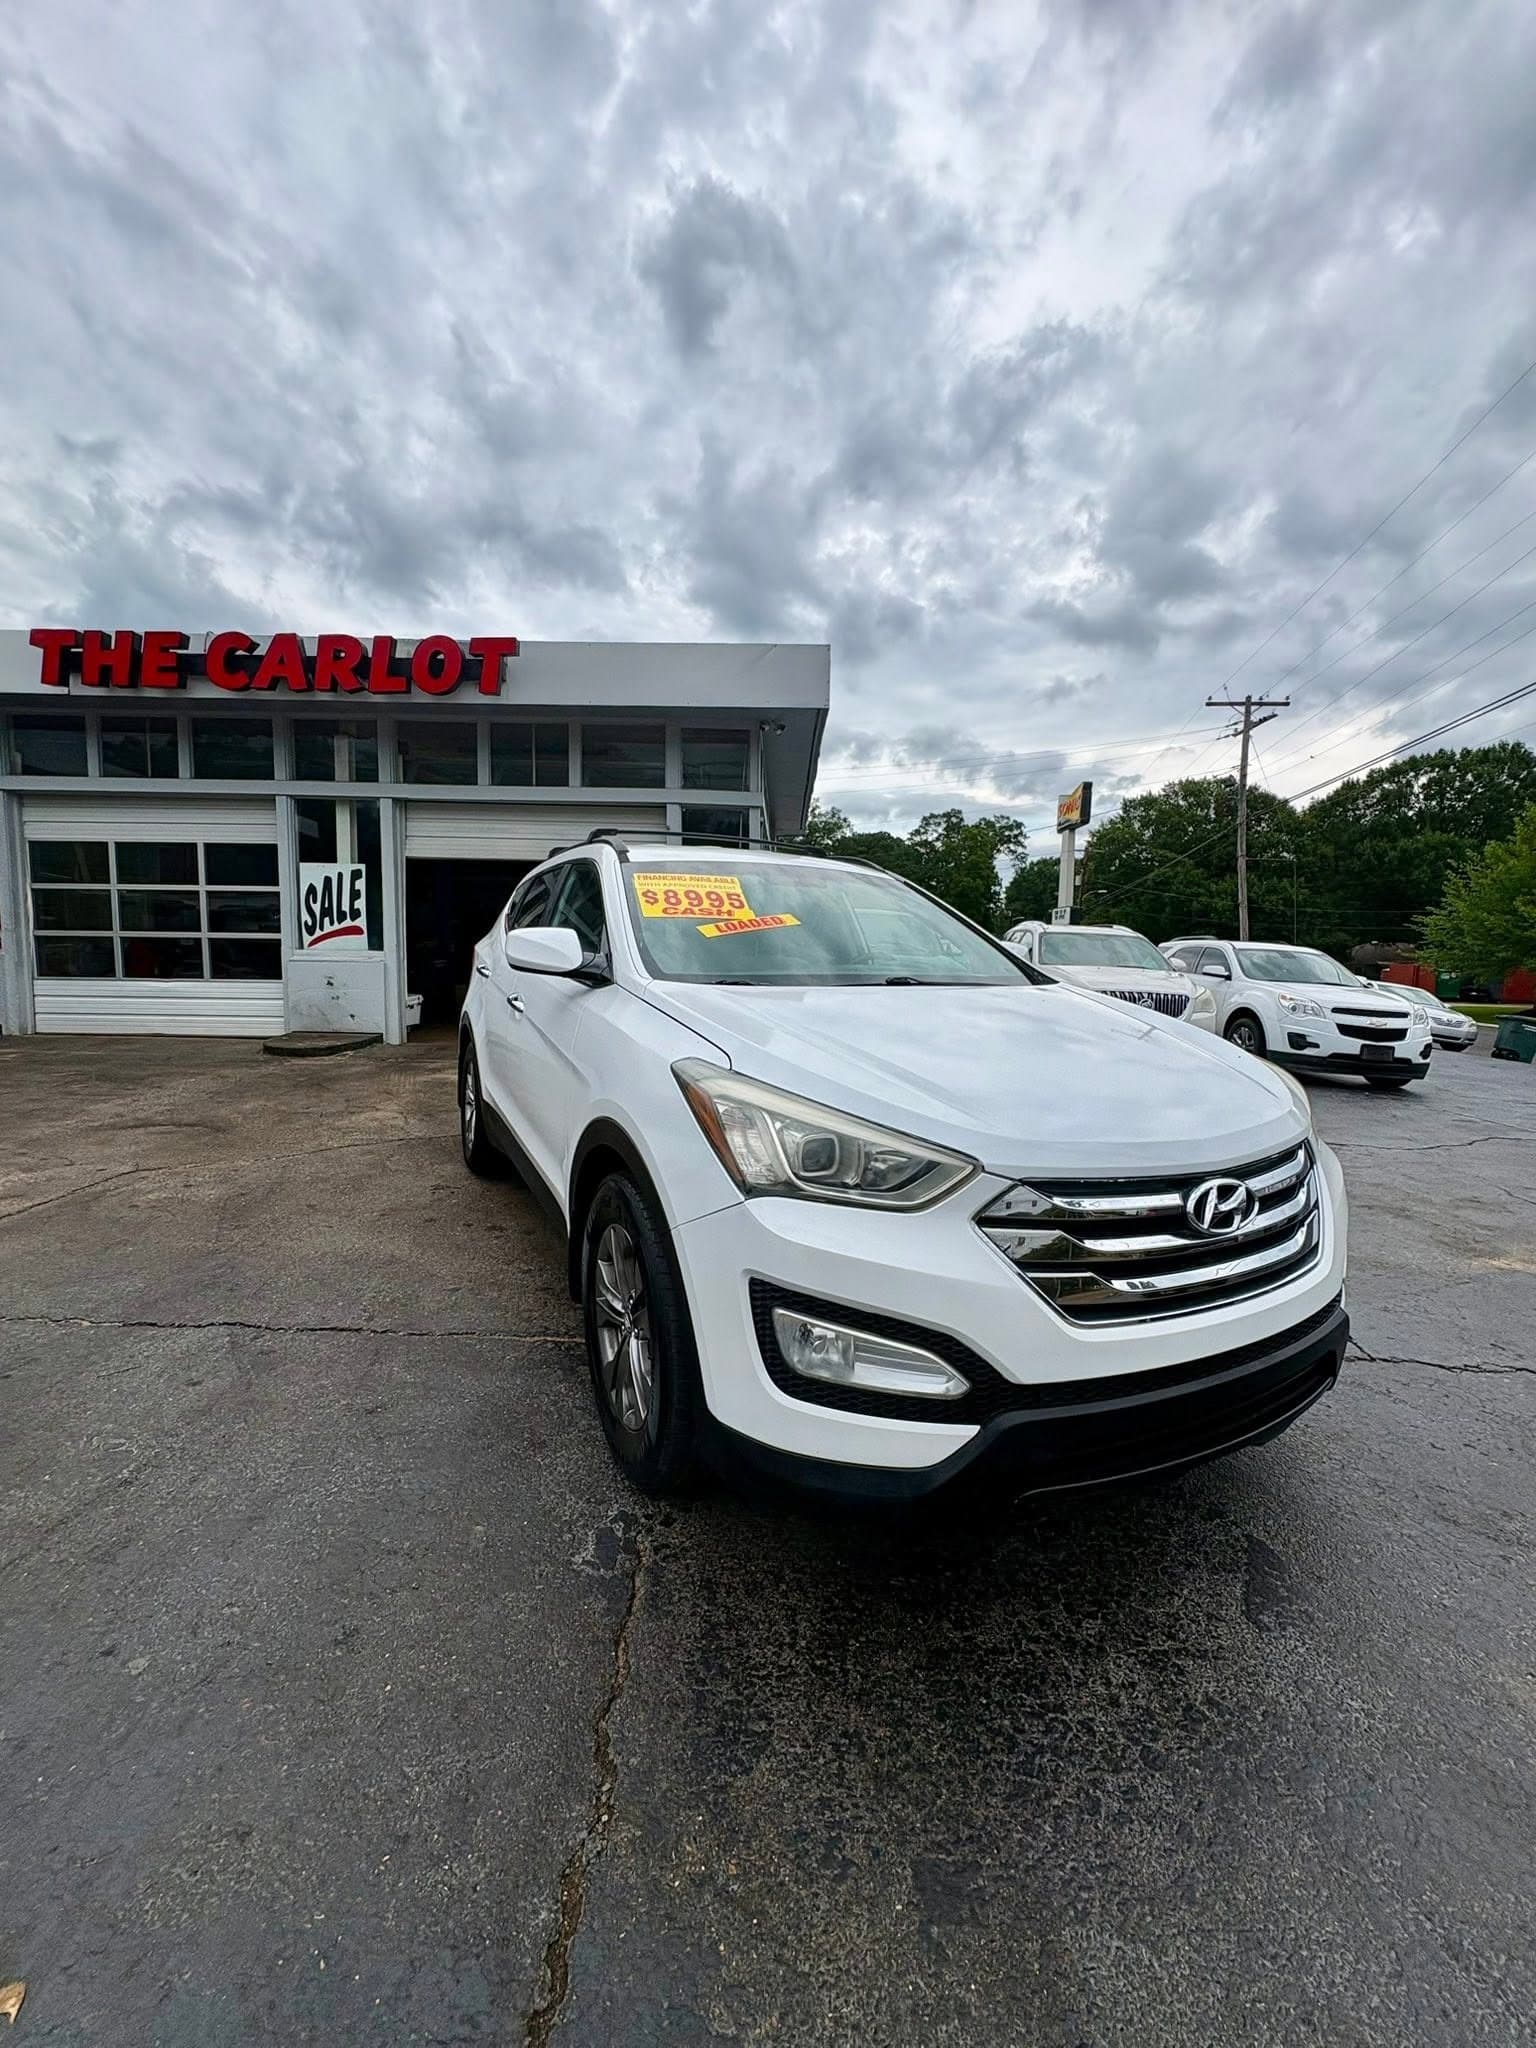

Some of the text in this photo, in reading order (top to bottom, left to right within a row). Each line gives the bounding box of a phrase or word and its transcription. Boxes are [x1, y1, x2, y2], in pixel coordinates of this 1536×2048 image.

[30, 628, 520, 696] THE CARLOT
[304, 868, 362, 937] SALE
[642, 889, 745, 909] $8995
[662, 907, 734, 917] CASH
[714, 916, 784, 934] LOADED
